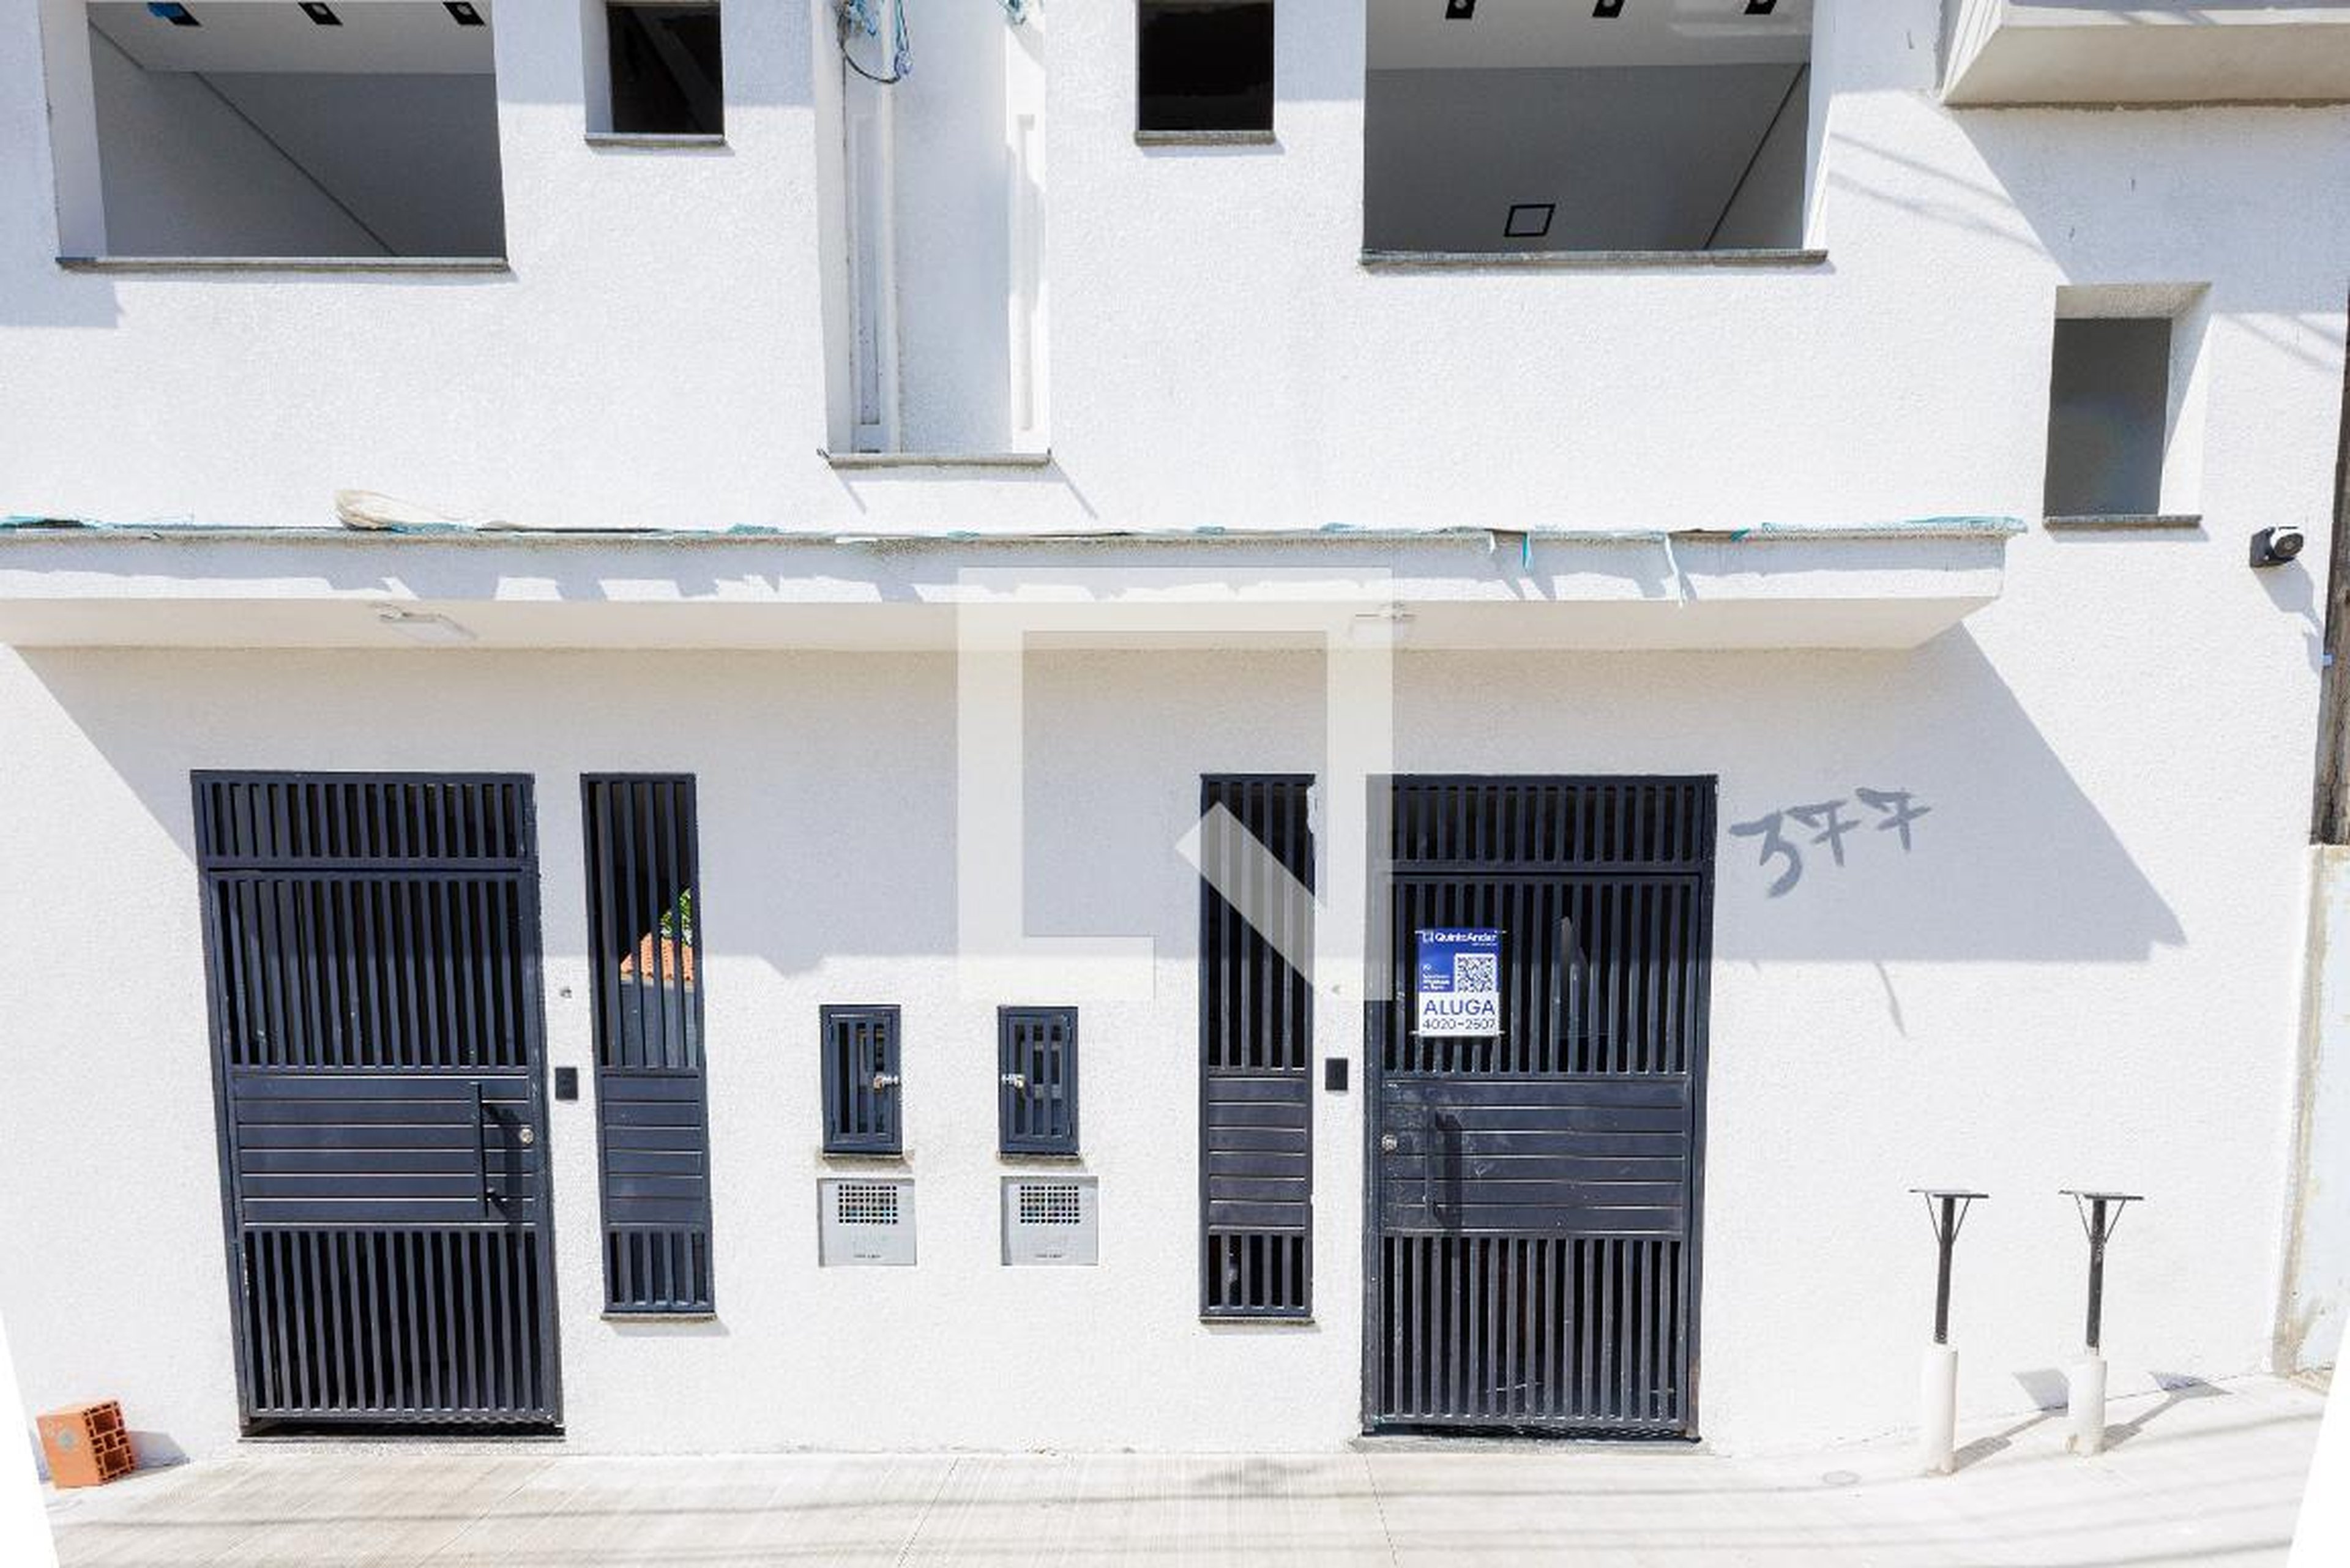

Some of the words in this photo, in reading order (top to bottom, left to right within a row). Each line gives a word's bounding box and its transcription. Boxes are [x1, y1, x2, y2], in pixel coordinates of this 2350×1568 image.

[1728, 786, 1932, 898] 377
[1423, 999, 1495, 1015] ALUGA
[1422, 1018, 1495, 1029] 4020-2507
